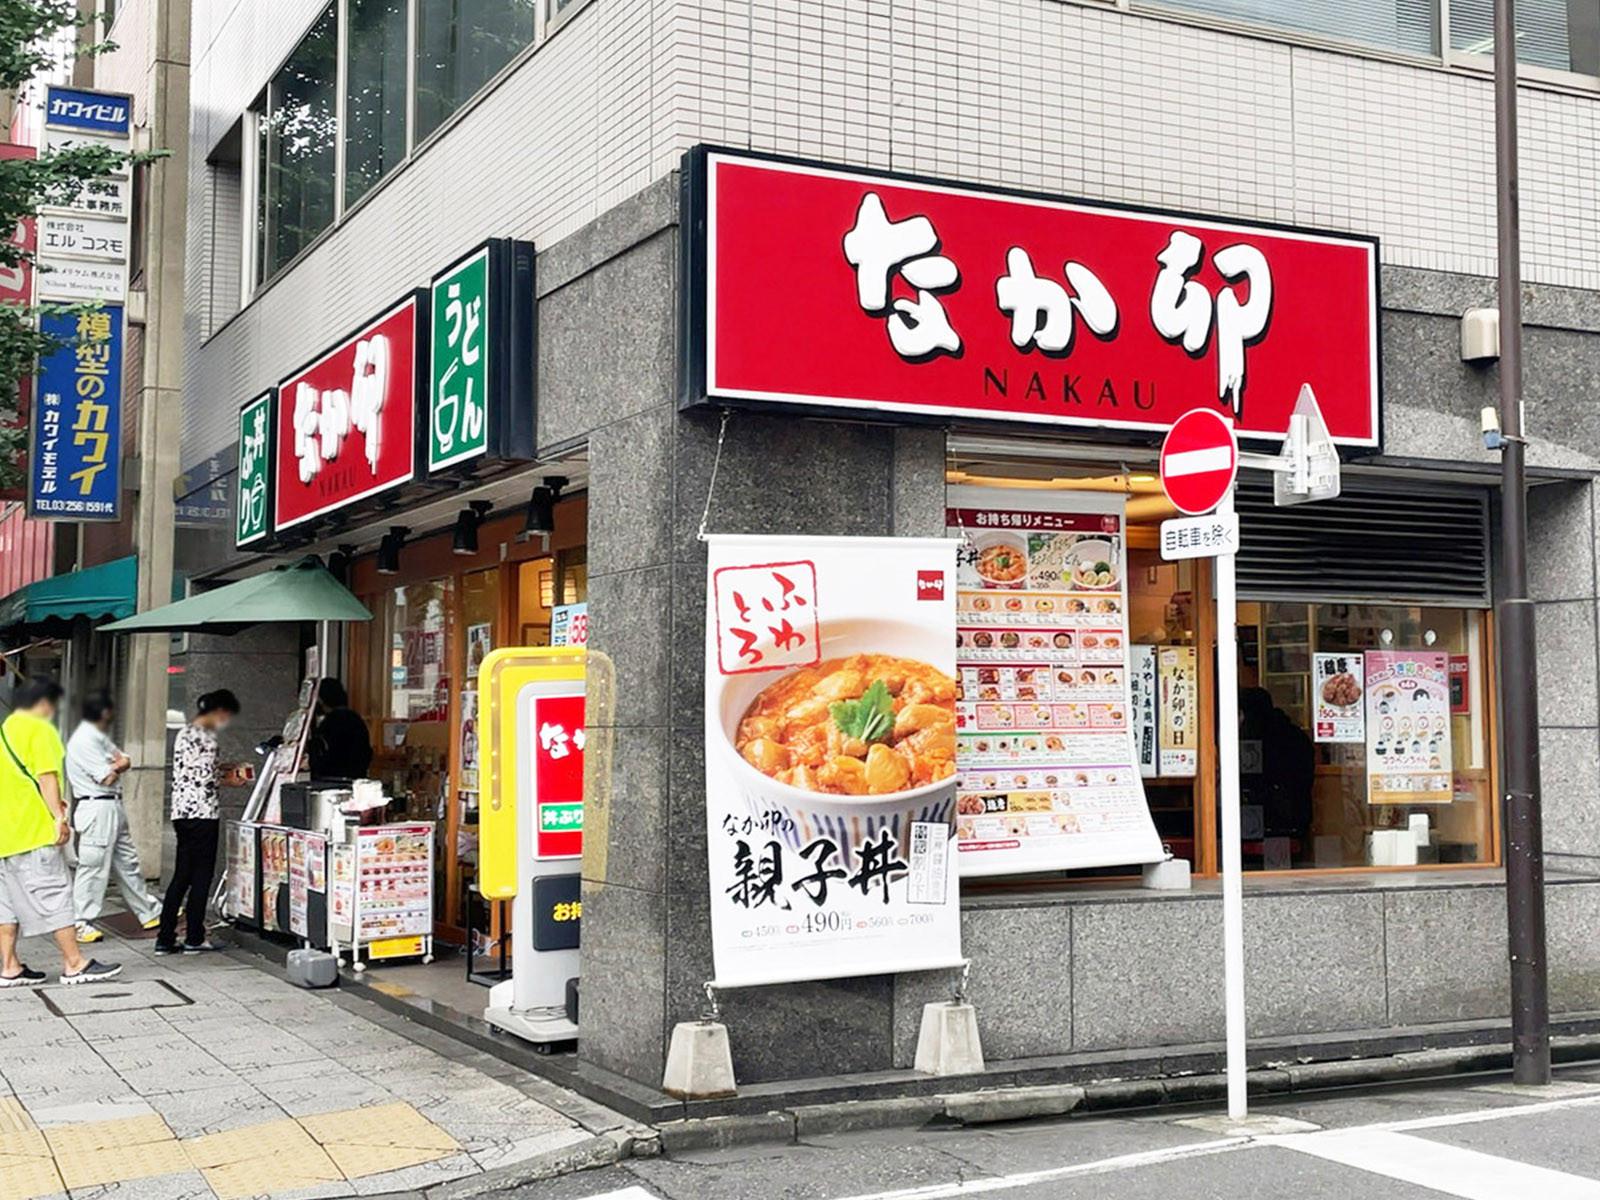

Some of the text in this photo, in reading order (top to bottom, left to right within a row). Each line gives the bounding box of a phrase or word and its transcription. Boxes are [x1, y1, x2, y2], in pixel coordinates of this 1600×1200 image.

[50, 99, 127, 124] カワイビル
[46, 221, 85, 233] 株式会社
[46, 233, 123, 254] エル コスモ
[844, 193, 1273, 417] なか卯
[446, 283, 483, 443] うどん
[984, 366, 1156, 411] NAKAU
[70, 312, 112, 495] 模型のカワイ
[293, 335, 389, 484] なか卯
[976, 512, 1075, 528] お持ち帰りメニュー
[1166, 524, 1232, 551] 自転車を除く
[729, 591, 763, 664] とろ
[762, 572, 807, 651] ふわ
[1172, 666, 1186, 746] なか卯の日
[723, 810, 795, 836] なか卯の
[725, 830, 907, 910] 親子丼
